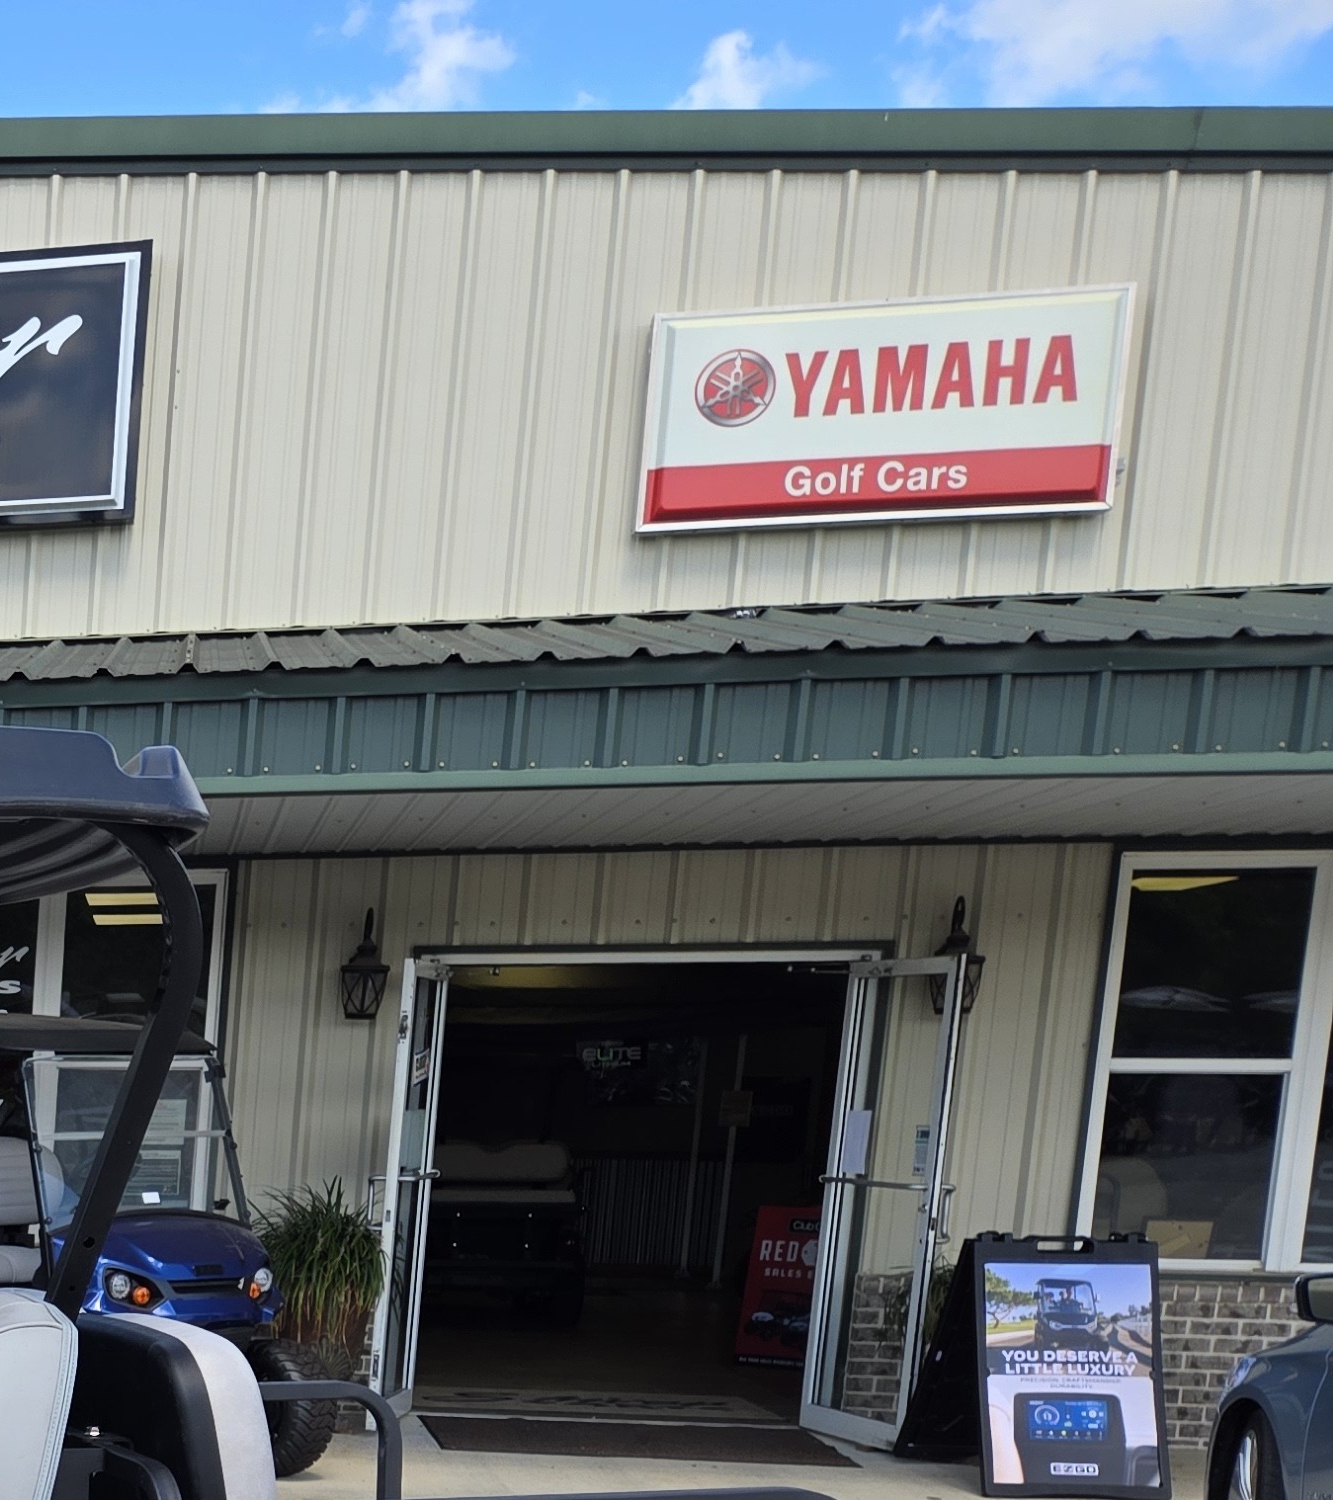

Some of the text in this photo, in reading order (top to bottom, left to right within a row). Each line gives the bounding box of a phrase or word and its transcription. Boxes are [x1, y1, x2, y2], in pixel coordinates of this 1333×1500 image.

[785, 335, 1078, 417] YAMAHA
[784, 460, 968, 497] Golf Cars
[759, 1240, 800, 1262] RED
[1001, 1350, 1139, 1364] YOU DESERVE A
[1005, 1363, 1136, 1376] LITTLE LUXURY
